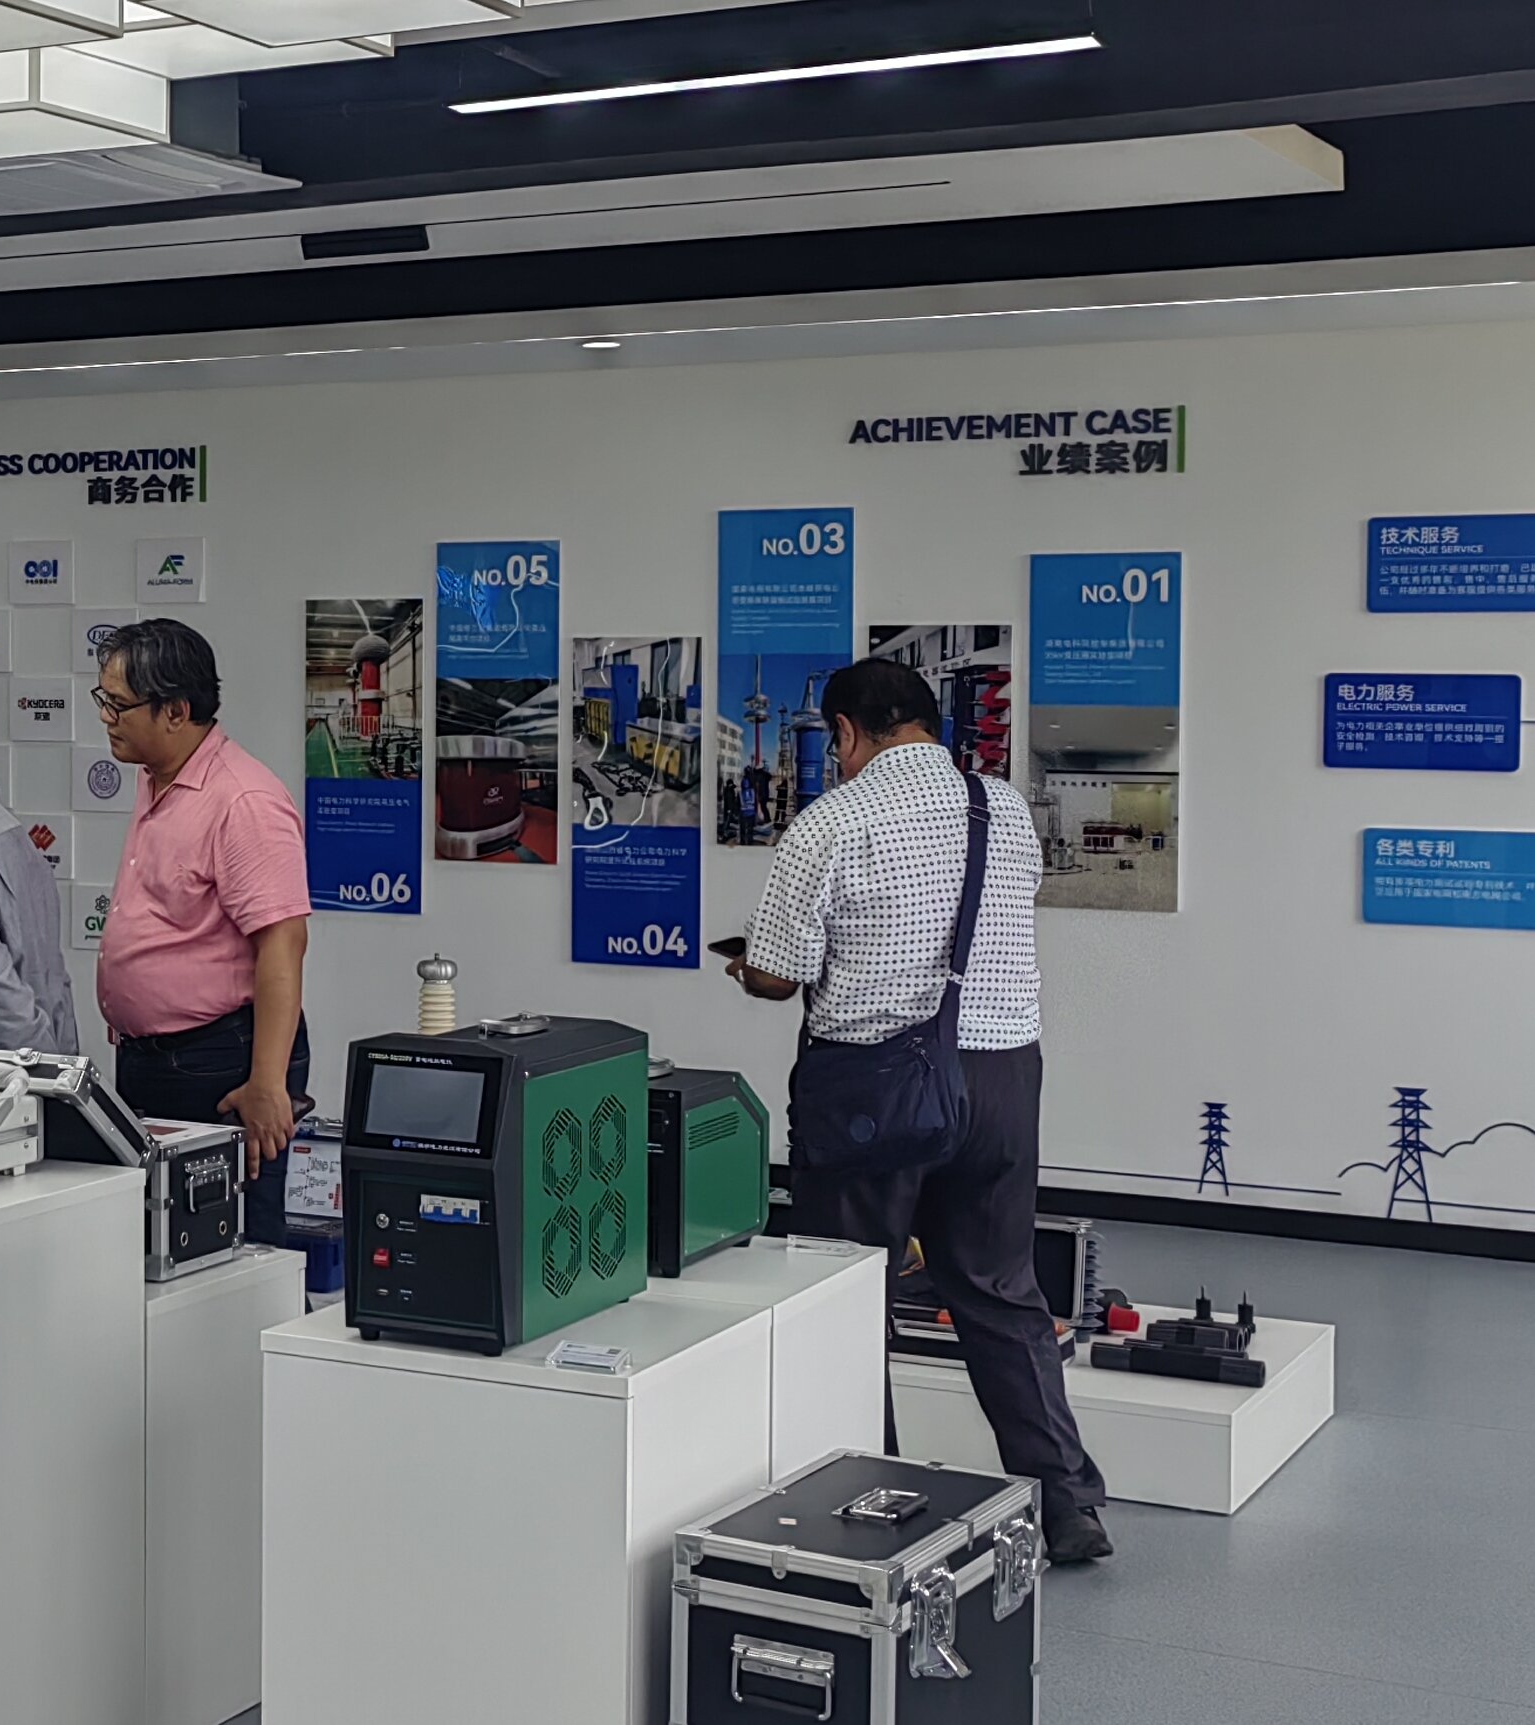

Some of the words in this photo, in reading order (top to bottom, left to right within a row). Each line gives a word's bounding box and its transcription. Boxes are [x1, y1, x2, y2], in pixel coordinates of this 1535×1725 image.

[848, 411, 1078, 444] ACHIEVEMENT
[1085, 408, 1172, 435] CASE
[28, 447, 196, 475] COOPERATION
[1019, 439, 1168, 476] 业绩案例
[87, 474, 195, 505] 商务合作
[762, 521, 846, 556] NO.03
[1380, 526, 1460, 545] 技术服务
[1380, 545, 1438, 556] TECHNIQUE
[1441, 544, 1484, 554] SERVICE
[473, 554, 549, 586] NO.05
[1081, 568, 1170, 604] NO.01
[27, 699, 65, 709] KYOCERA
[1338, 683, 1415, 701] 电力服务
[1336, 702, 1383, 712] ELECTRIC
[1385, 703, 1423, 713] POWER
[1425, 703, 1468, 713] SERVICE
[1376, 838, 1456, 858] 各类专利
[1375, 858, 1394, 866] ALL
[1396, 859, 1428, 868] KINDS
[1429, 859, 1444, 868] OF
[1446, 860, 1491, 870] PATENTS
[339, 872, 412, 904] NO.06
[607, 923, 689, 958] NO.04
